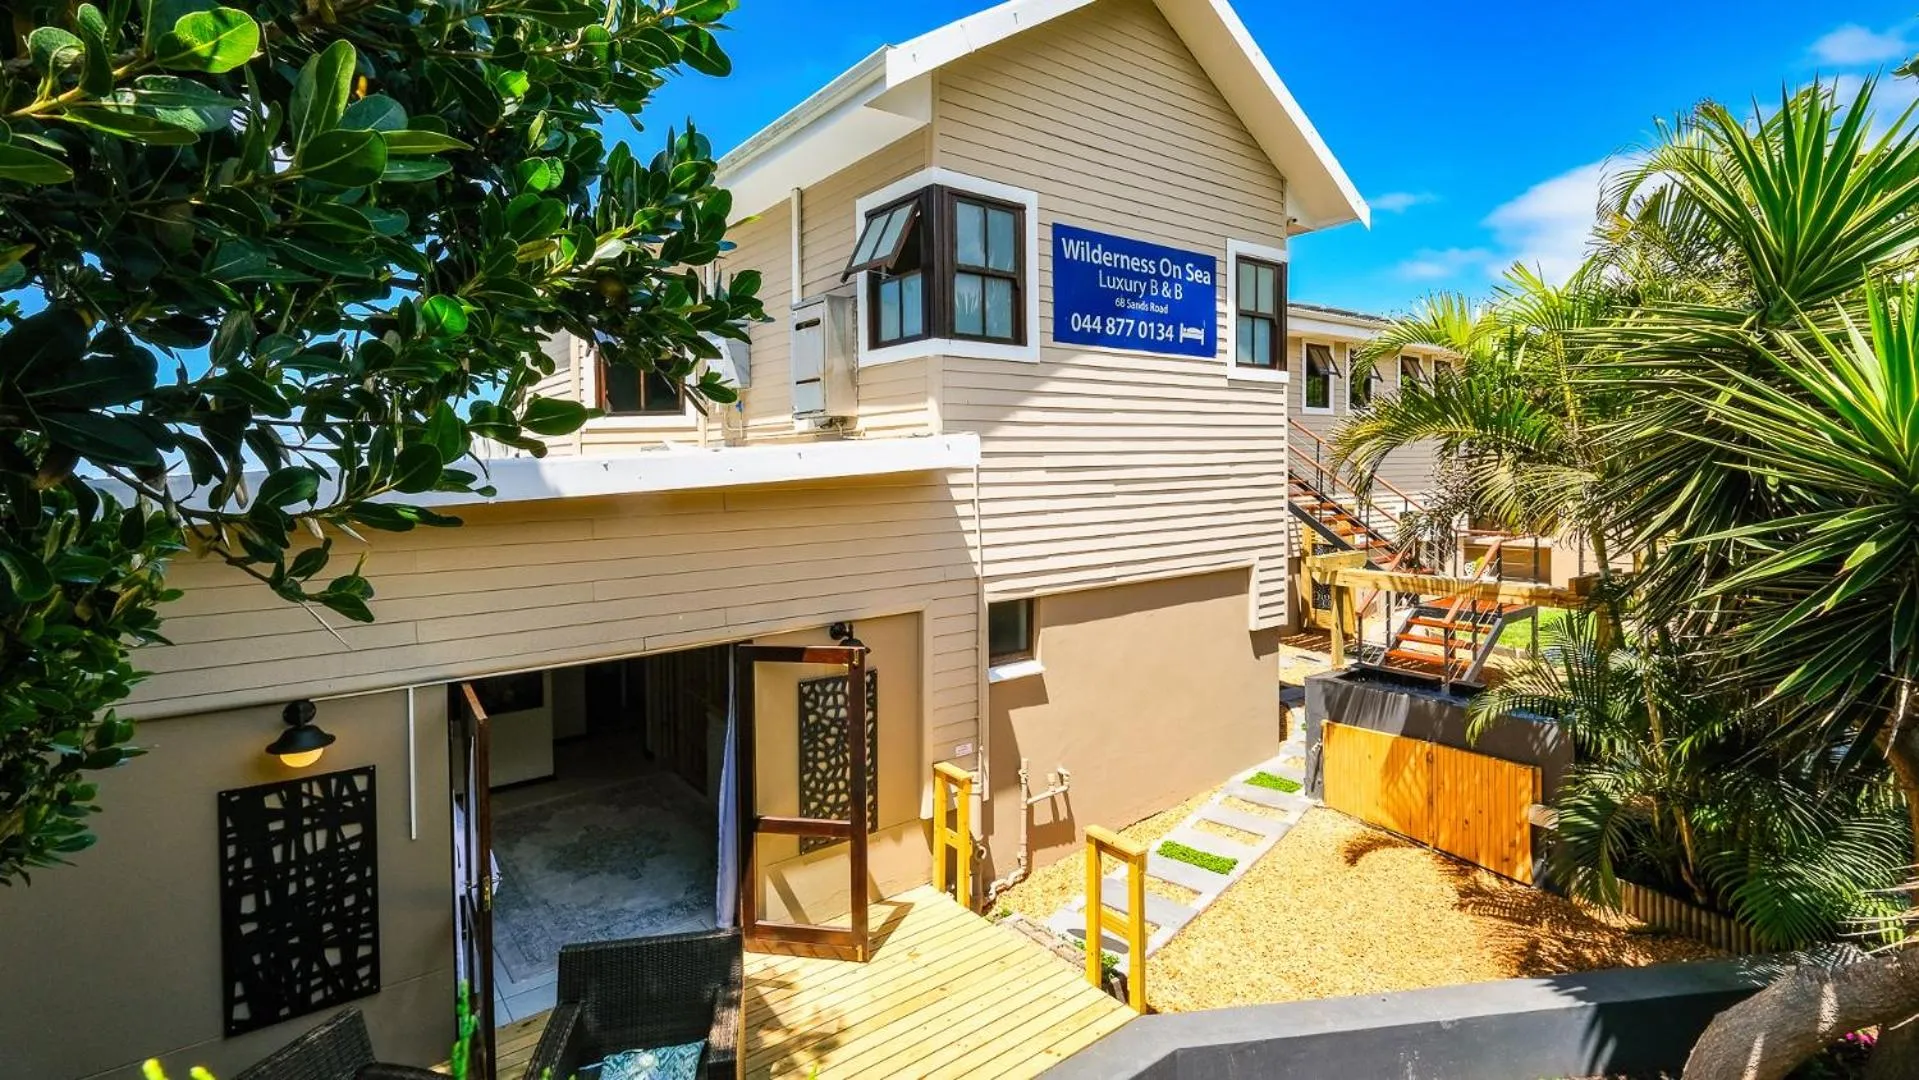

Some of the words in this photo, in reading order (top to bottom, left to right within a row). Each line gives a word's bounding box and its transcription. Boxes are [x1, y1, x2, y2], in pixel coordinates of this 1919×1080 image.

[1062, 238, 1155, 274] Wilderness
[1160, 258, 1181, 279] On
[1186, 263, 1211, 285] Sea
[1099, 270, 1147, 298] Luxury
[1151, 279, 1159, 296] B
[1161, 281, 1172, 299] &
[1175, 283, 1183, 300] B
[1115, 297, 1126, 307] 68
[1126, 298, 1149, 311] Sands
[1150, 301, 1168, 314] Road
[1071, 312, 1102, 334] 044
[1105, 317, 1135, 337] 877
[1138, 321, 1174, 342] 0134
